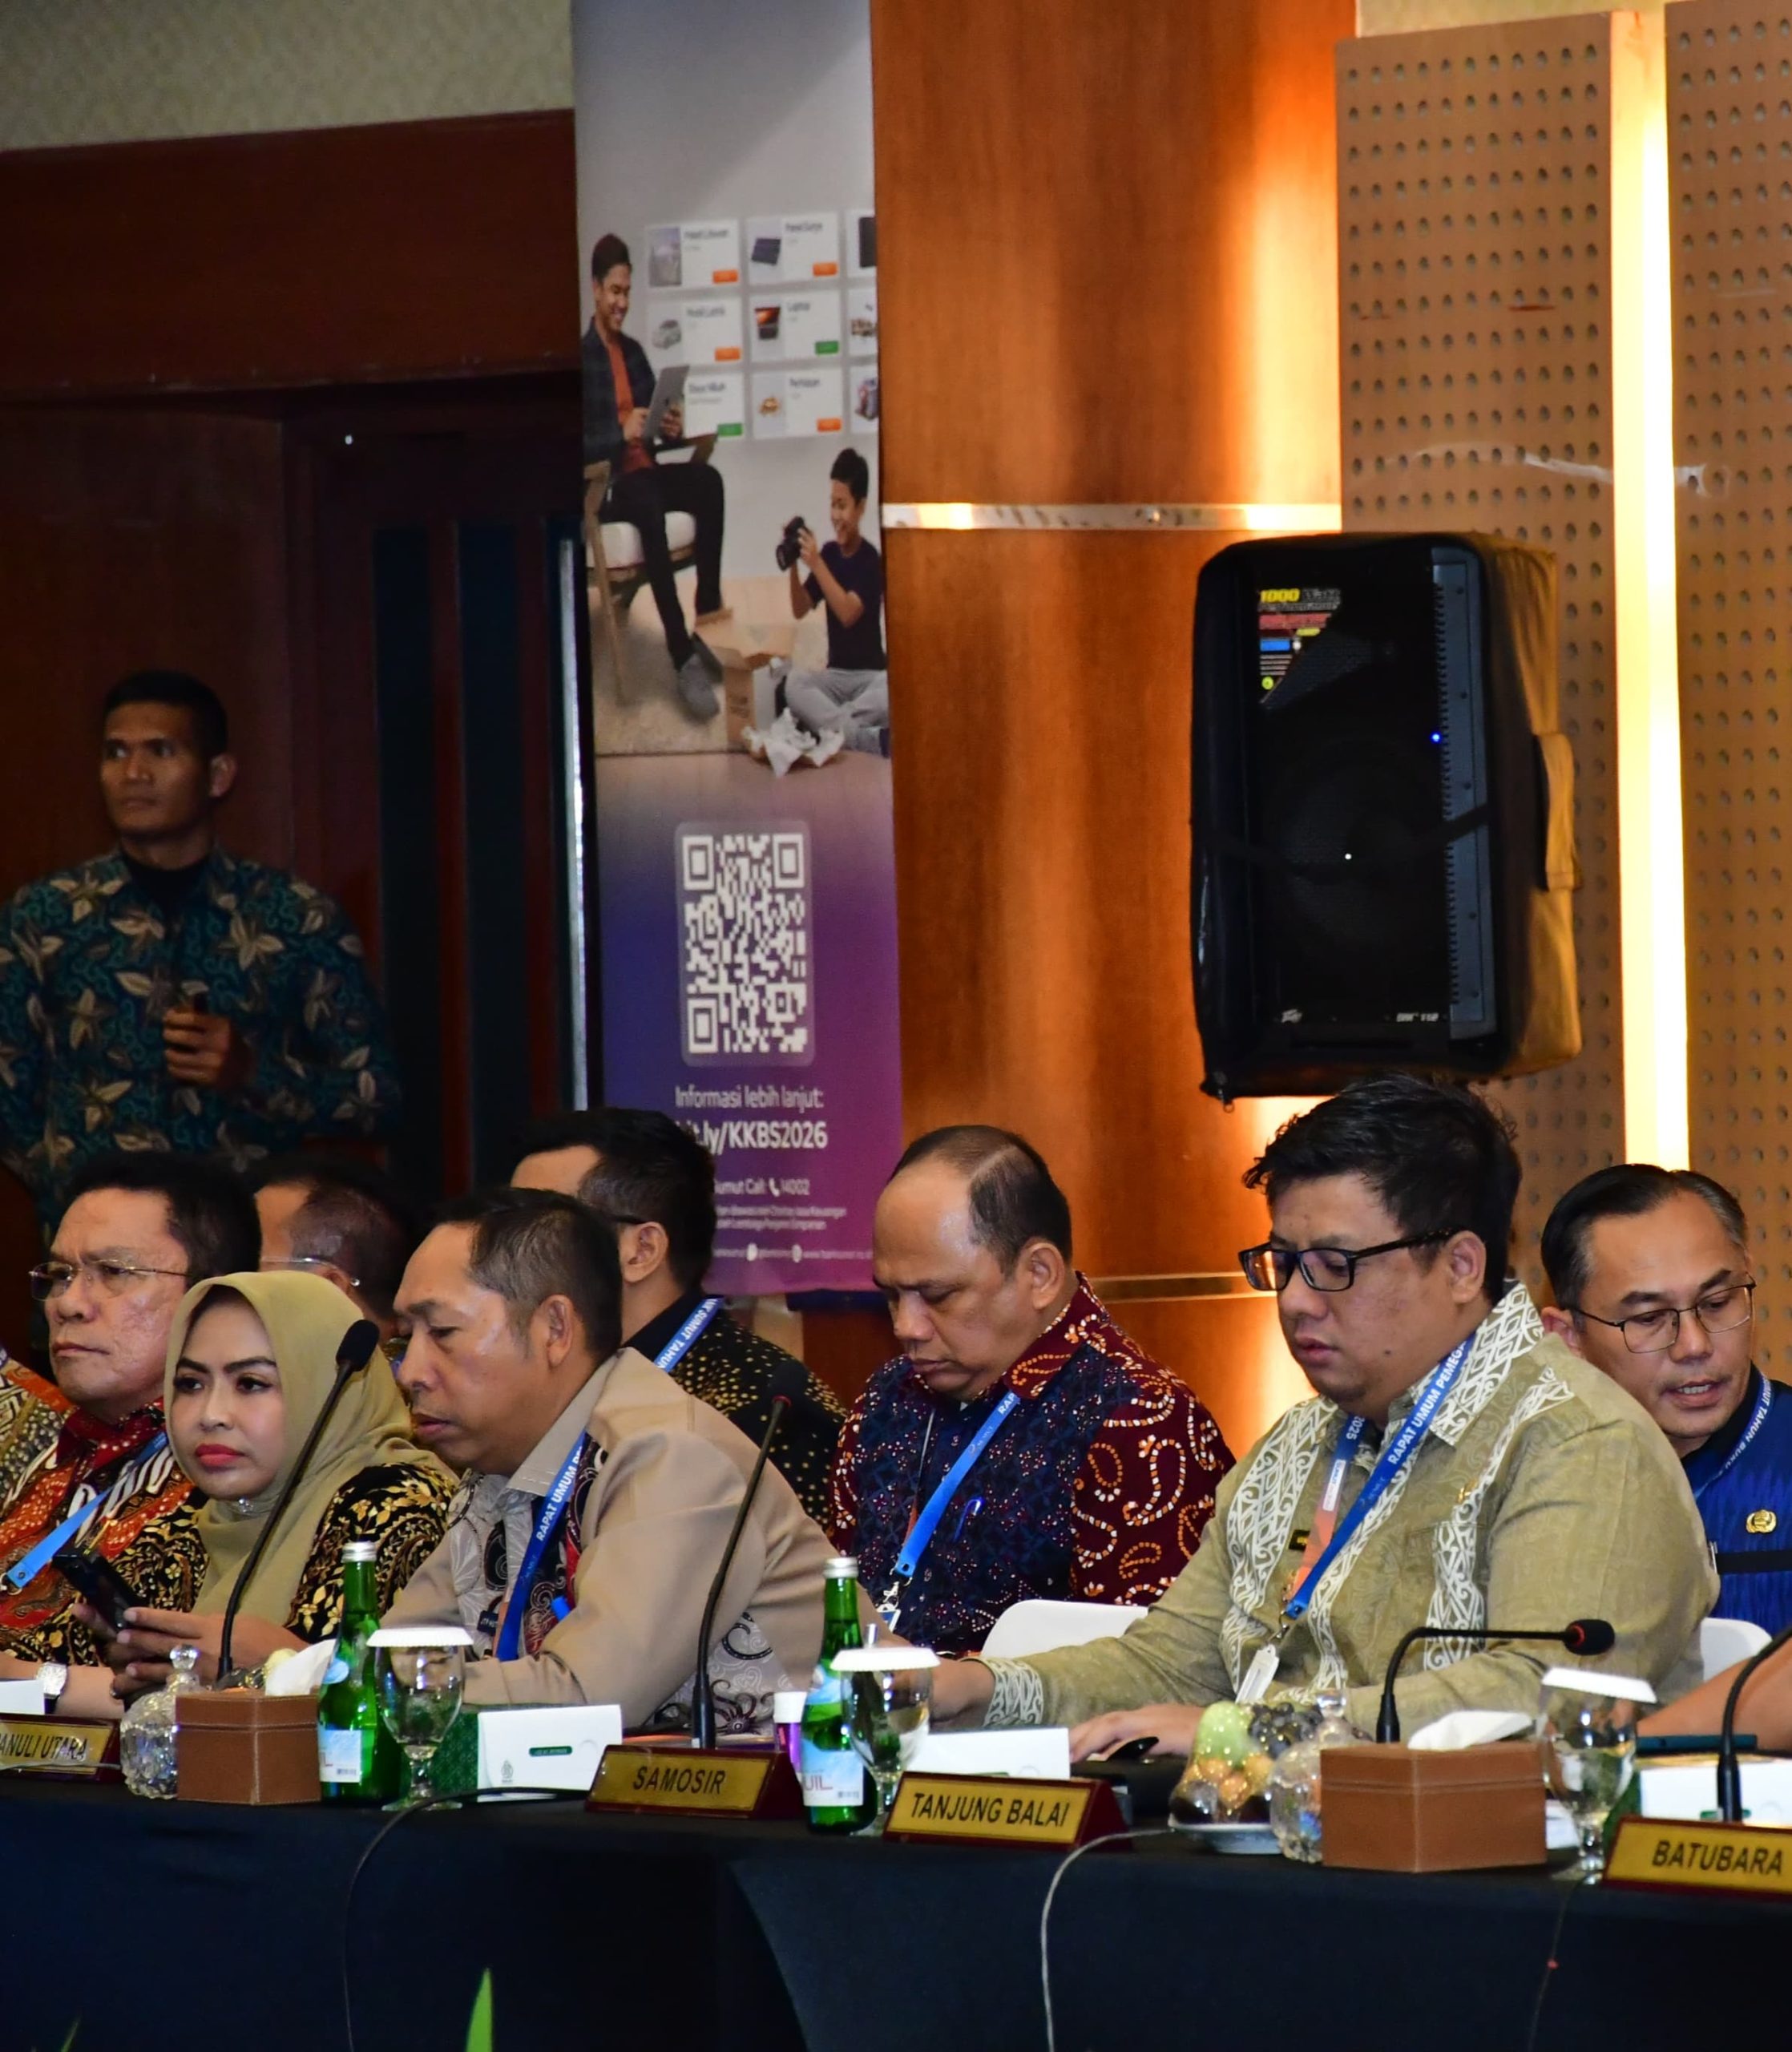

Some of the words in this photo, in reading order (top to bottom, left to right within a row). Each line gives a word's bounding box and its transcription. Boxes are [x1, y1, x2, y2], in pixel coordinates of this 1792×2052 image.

[1260, 588, 1300, 603] 1000
[675, 1085, 741, 1108] Informasi
[744, 1085, 780, 1108] lebih
[781, 1085, 824, 1114] lanjut:
[1386, 1426, 1417, 1464] RAPAT
[1411, 1388, 1442, 1428] UMUM
[1746, 1405, 1768, 1443] TAHUN
[535, 1503, 558, 1541] RAPAT
[551, 1465, 577, 1503] UMUM
[40, 1735, 87, 1761] UTARA
[632, 1765, 726, 1795] SAMOSIR
[910, 1792, 1003, 1824] TANJUNG
[1006, 1799, 1070, 1828] BALAI
[1651, 1839, 1783, 1876] BATUBARA
